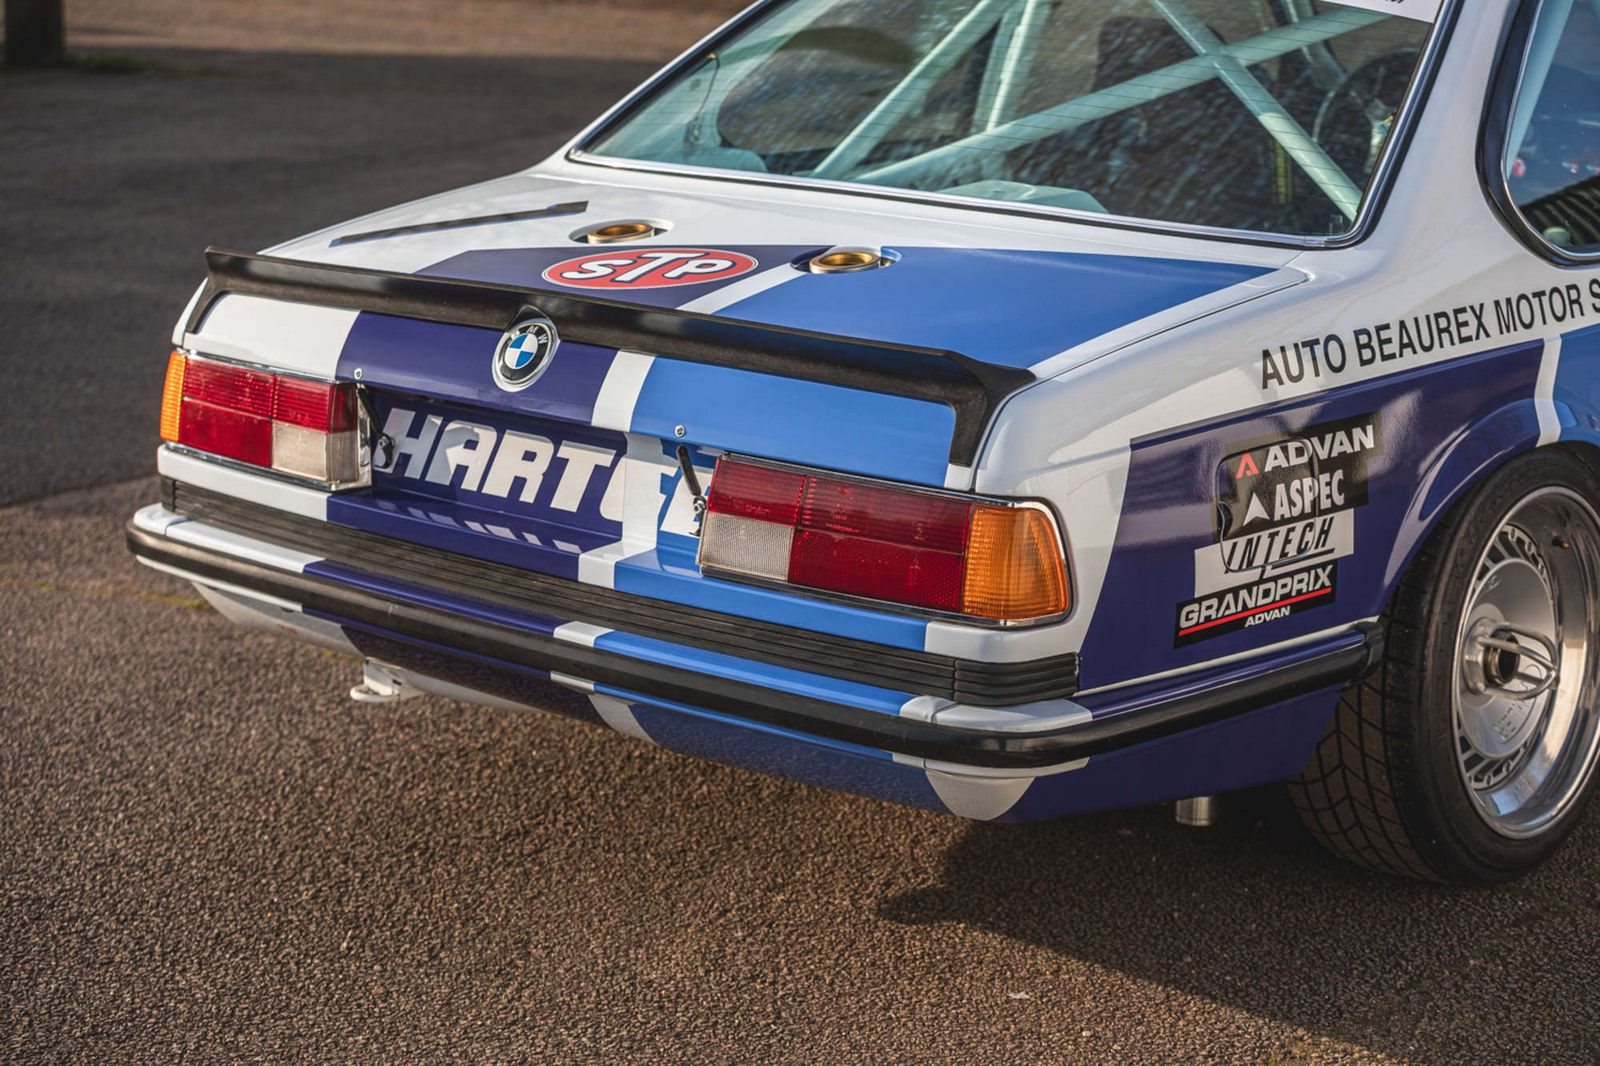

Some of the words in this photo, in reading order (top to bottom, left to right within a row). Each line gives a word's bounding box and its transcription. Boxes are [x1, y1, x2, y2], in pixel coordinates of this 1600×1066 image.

[560, 252, 735, 283] STP
[1262, 333, 1347, 390] AUTO
[1352, 302, 1491, 367] BEAUREX
[1493, 284, 1585, 335] MOTOR
[1264, 424, 1375, 472] ADVAN
[1273, 469, 1345, 521] ASPEC
[1223, 516, 1335, 575] INTECH
[1179, 564, 1334, 629] GRANDPRIX
[1244, 605, 1290, 628] ADVAN
